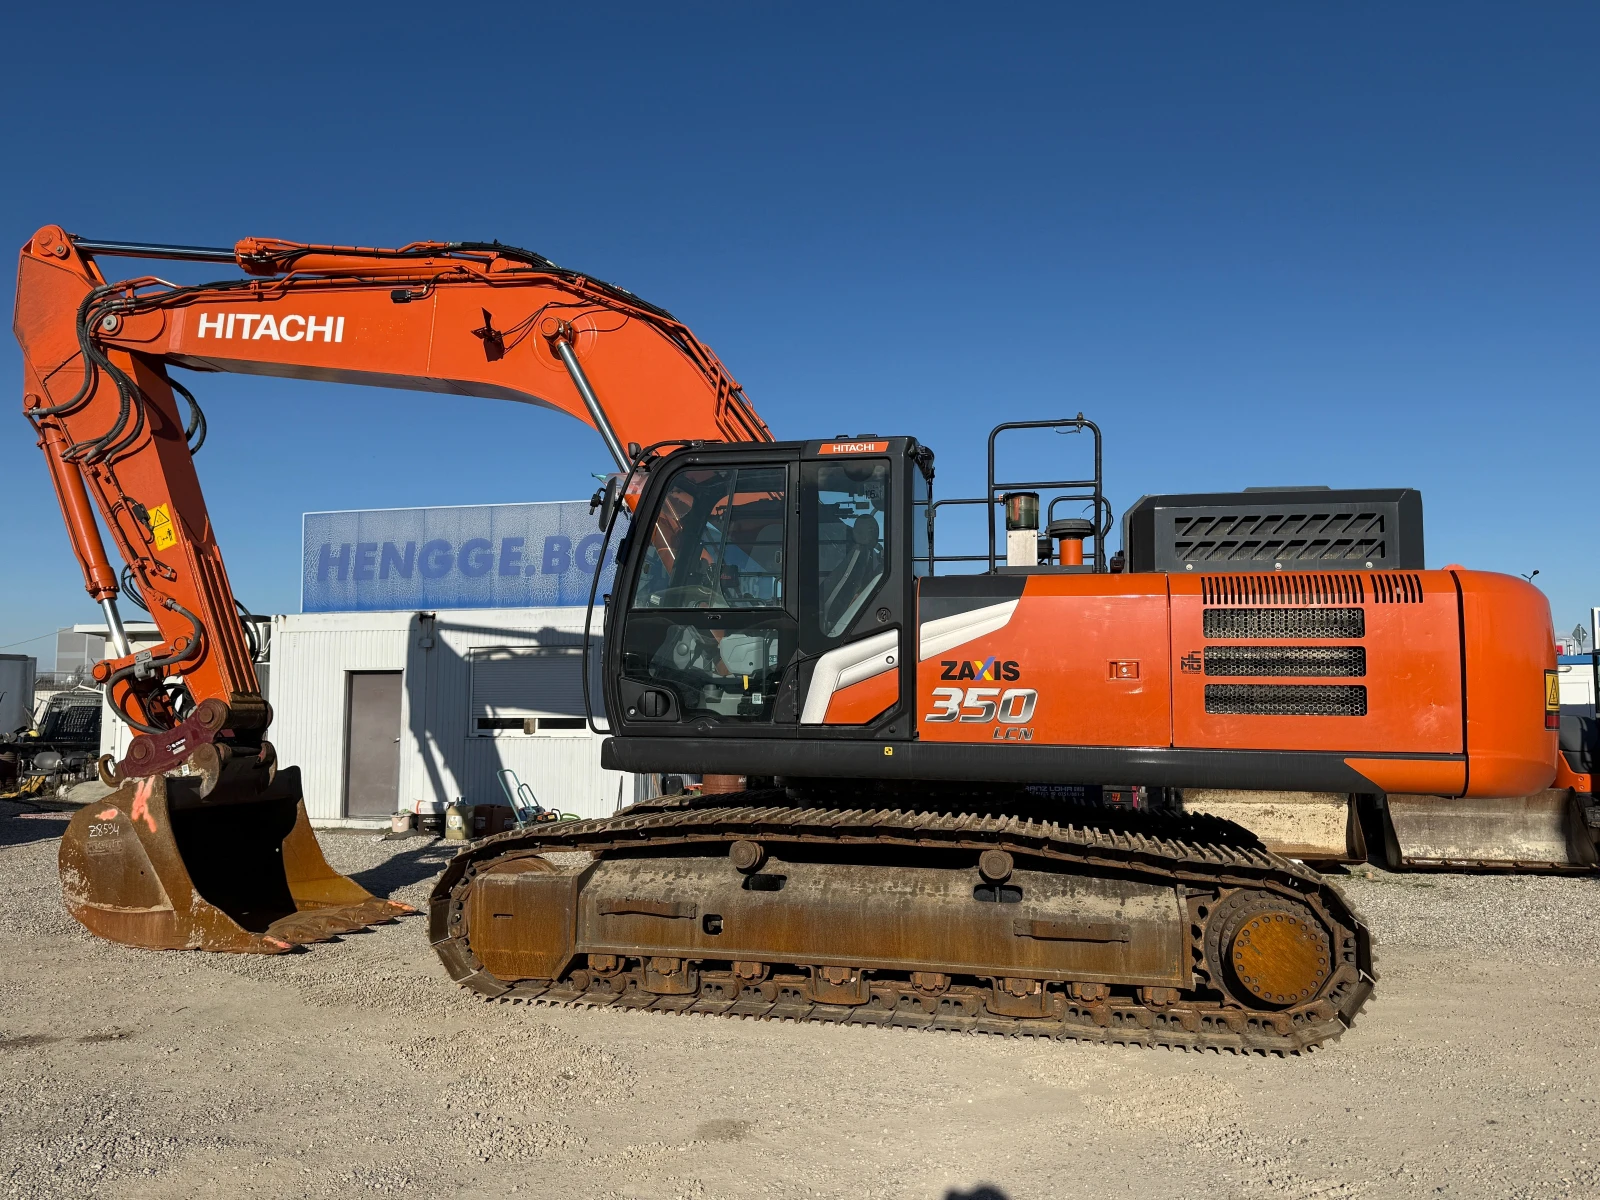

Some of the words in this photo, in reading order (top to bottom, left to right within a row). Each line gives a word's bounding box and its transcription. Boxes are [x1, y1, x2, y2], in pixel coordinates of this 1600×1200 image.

[197, 312, 345, 343] HITACHI
[833, 443, 875, 453] HITACHI
[940, 656, 1020, 681] ZAXIS
[924, 687, 1039, 724] 350
[993, 727, 1035, 741] LCN
